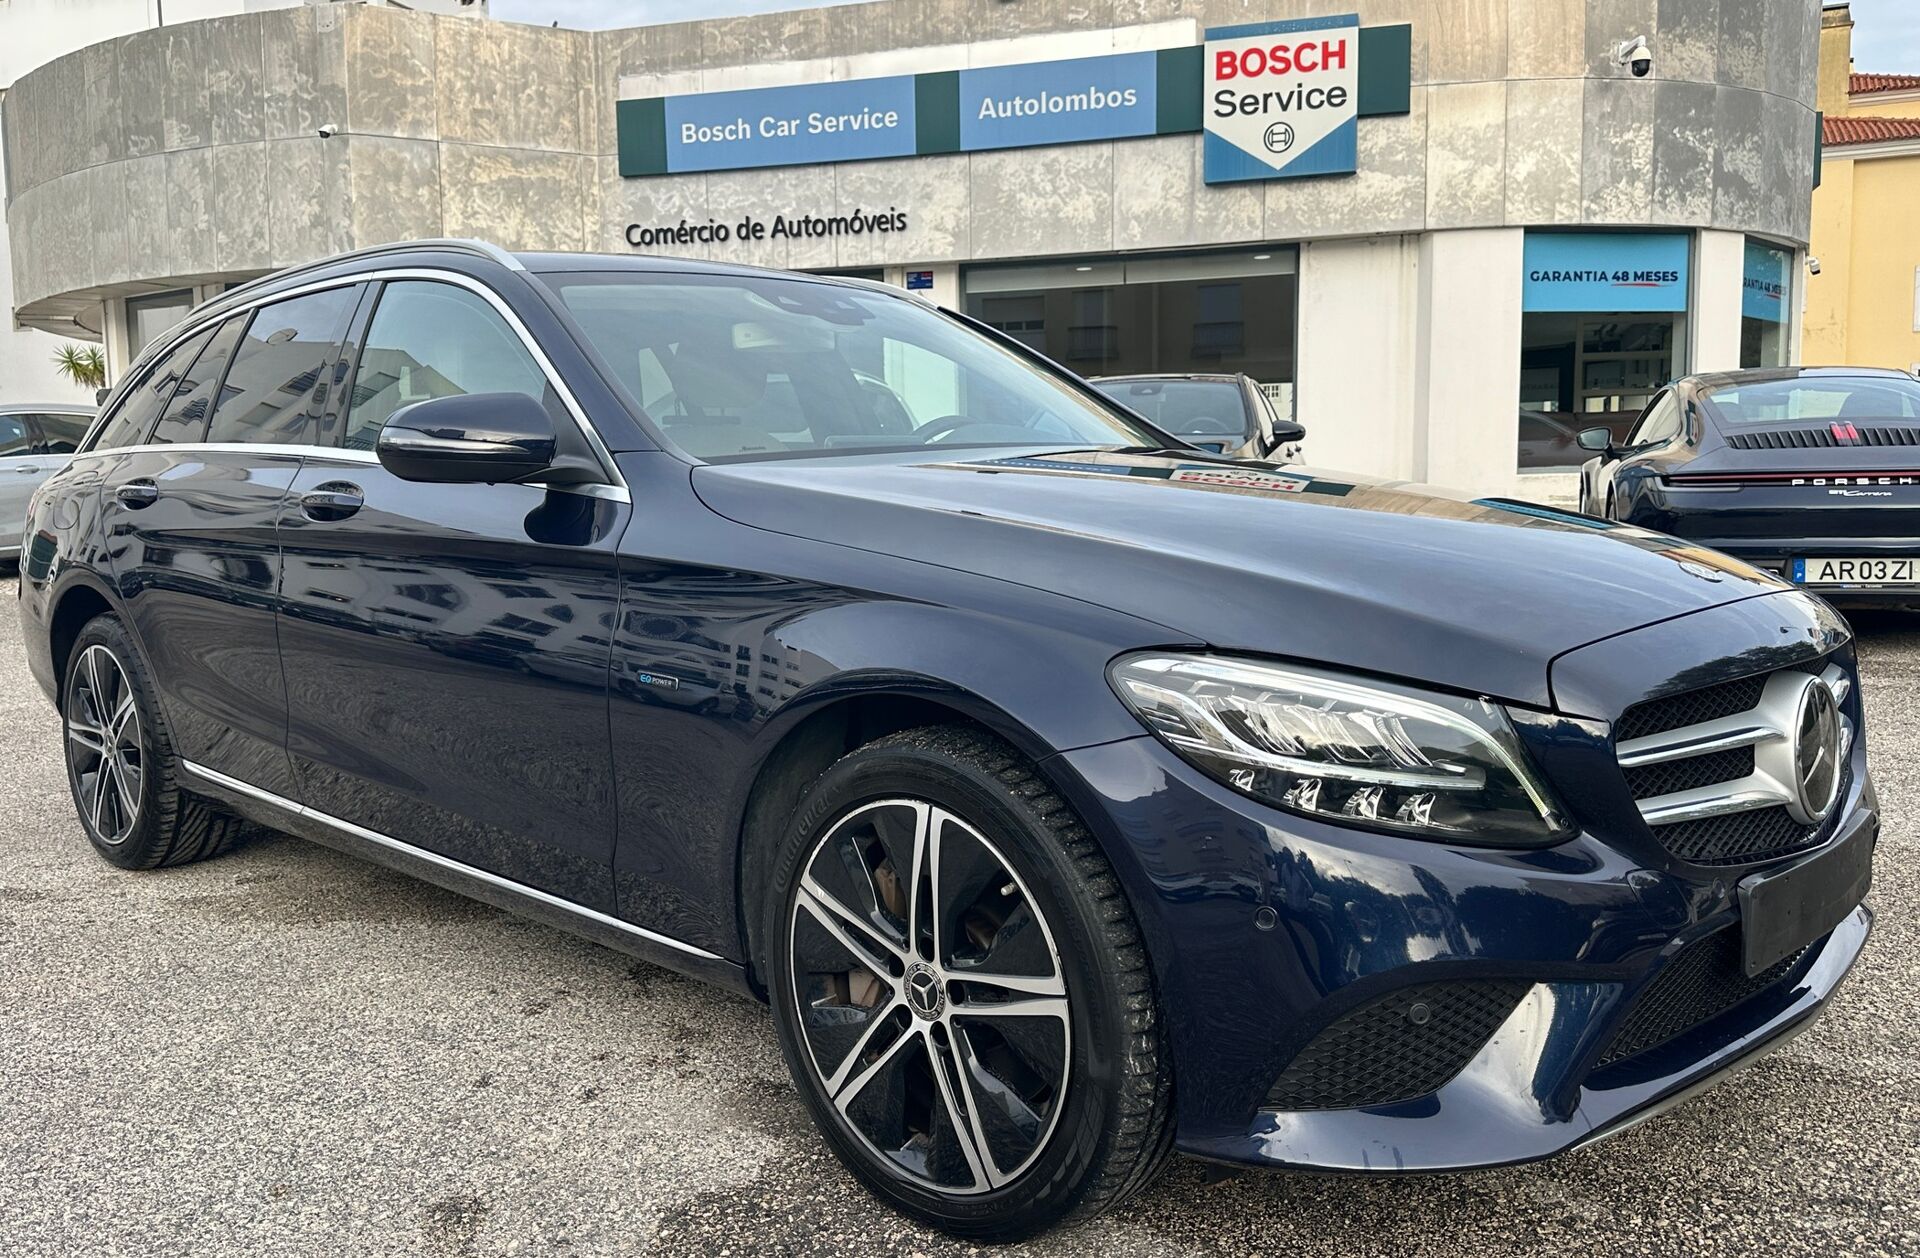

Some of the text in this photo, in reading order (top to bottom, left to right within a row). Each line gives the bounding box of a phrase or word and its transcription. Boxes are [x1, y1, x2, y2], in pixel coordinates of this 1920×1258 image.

[1215, 39, 1346, 81] BOSCH
[978, 86, 1137, 120] Autolombos
[1213, 83, 1347, 118] Service
[681, 107, 898, 144] Bosch Car Service
[625, 207, 907, 247] Comércio de Automóveis
[1530, 270, 1678, 282] GARANTIA 48 MESES
[1819, 561, 1914, 580] AR 03 ZI
[640, 674, 672, 686] EQ POWER
